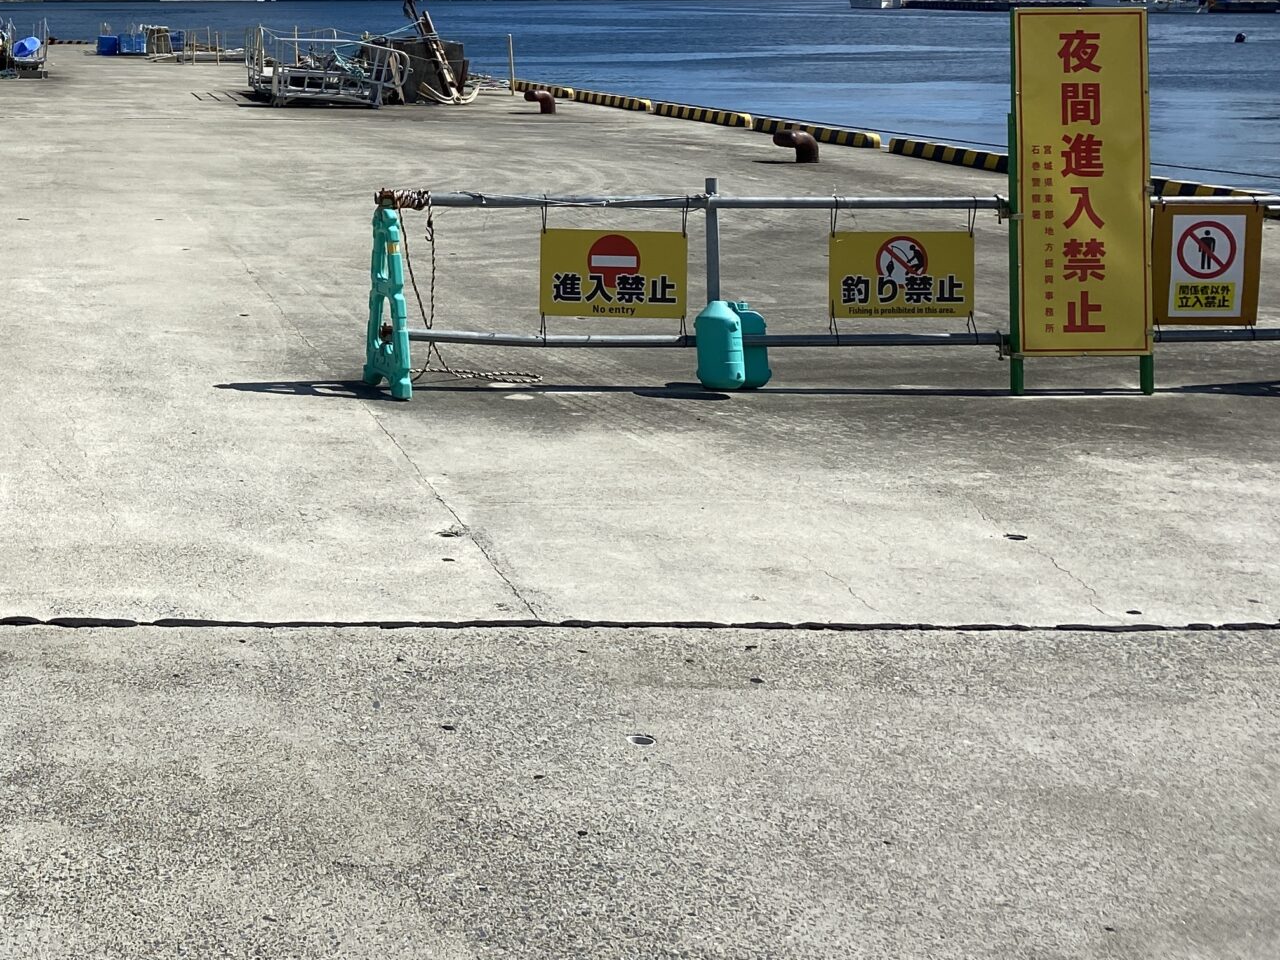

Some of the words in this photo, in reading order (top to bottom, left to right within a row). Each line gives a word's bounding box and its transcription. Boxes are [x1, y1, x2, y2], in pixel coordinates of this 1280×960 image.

[1057, 29, 1106, 333] 夜間進入禁止
[552, 272, 677, 304] 進入禁止
[841, 275, 964, 304] 釣り禁止
[1178, 285, 1230, 295] 関係者以外
[1178, 296, 1230, 308] 立入禁止
[592, 304, 606, 314] No
[608, 304, 636, 316] entry
[848, 307, 873, 316] Fishing
[880, 306, 916, 315] prohibited
[924, 306, 937, 314] this
